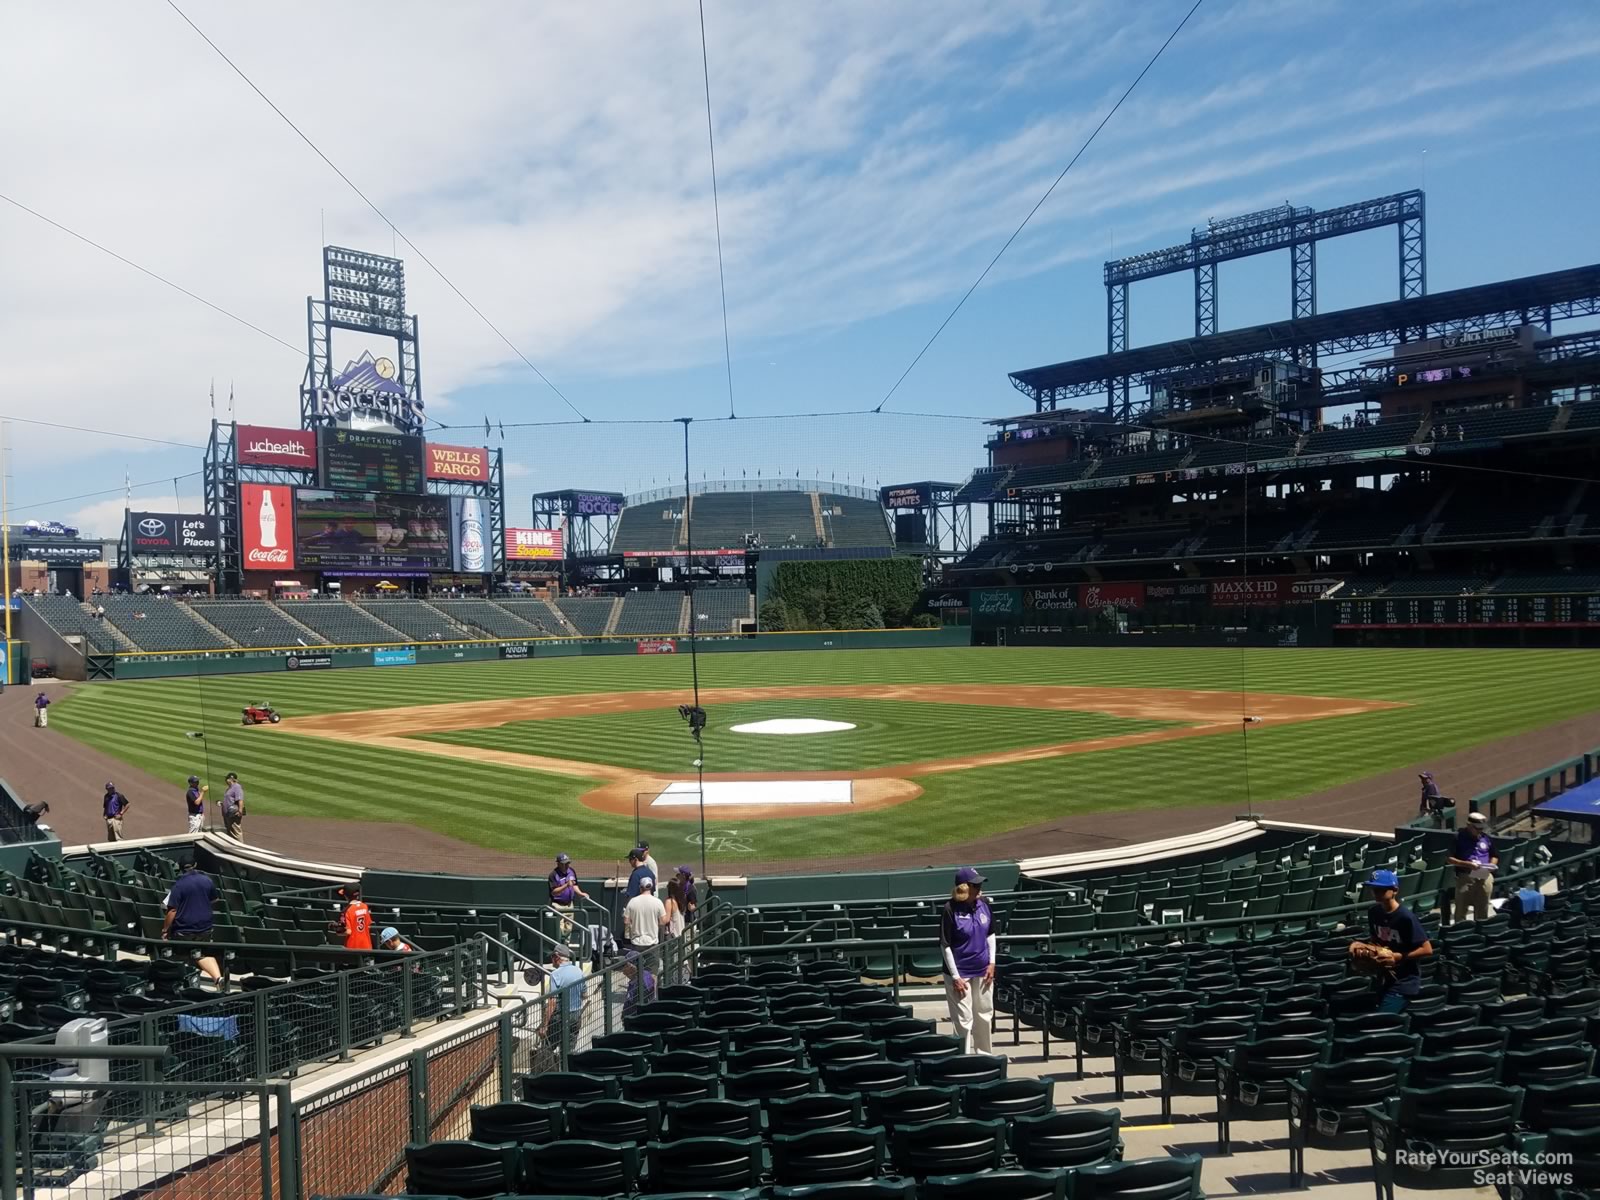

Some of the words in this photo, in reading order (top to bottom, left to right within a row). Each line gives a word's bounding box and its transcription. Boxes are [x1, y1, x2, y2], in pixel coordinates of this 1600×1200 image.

[312, 386, 427, 428] ROCKIES
[349, 434, 403, 446] DRAFTKINGS
[250, 437, 305, 456] uchealth
[432, 449, 481, 464] WELLS
[434, 462, 481, 477] FARGO
[577, 494, 610, 503] COLORADO
[889, 495, 921, 507] PIRATES
[37, 525, 65, 534] TOYOTA
[183, 519, 205, 530] Let's
[183, 529, 196, 538] Go
[516, 531, 553, 545] KING
[135, 537, 170, 546] TOYOTA
[183, 538, 215, 547] Places
[28, 547, 101, 558] TUNDRA
[1213, 581, 1255, 593] MAXX
[1257, 581, 1277, 592] HD
[1035, 589, 1056, 599] Bank
[1058, 588, 1069, 599] of
[1213, 592, 1277, 600] sunglasses
[928, 599, 963, 608] Safelite
[979, 598, 1012, 612] dental
[1035, 600, 1077, 610] Colorado
[356, 915, 366, 933] 3
